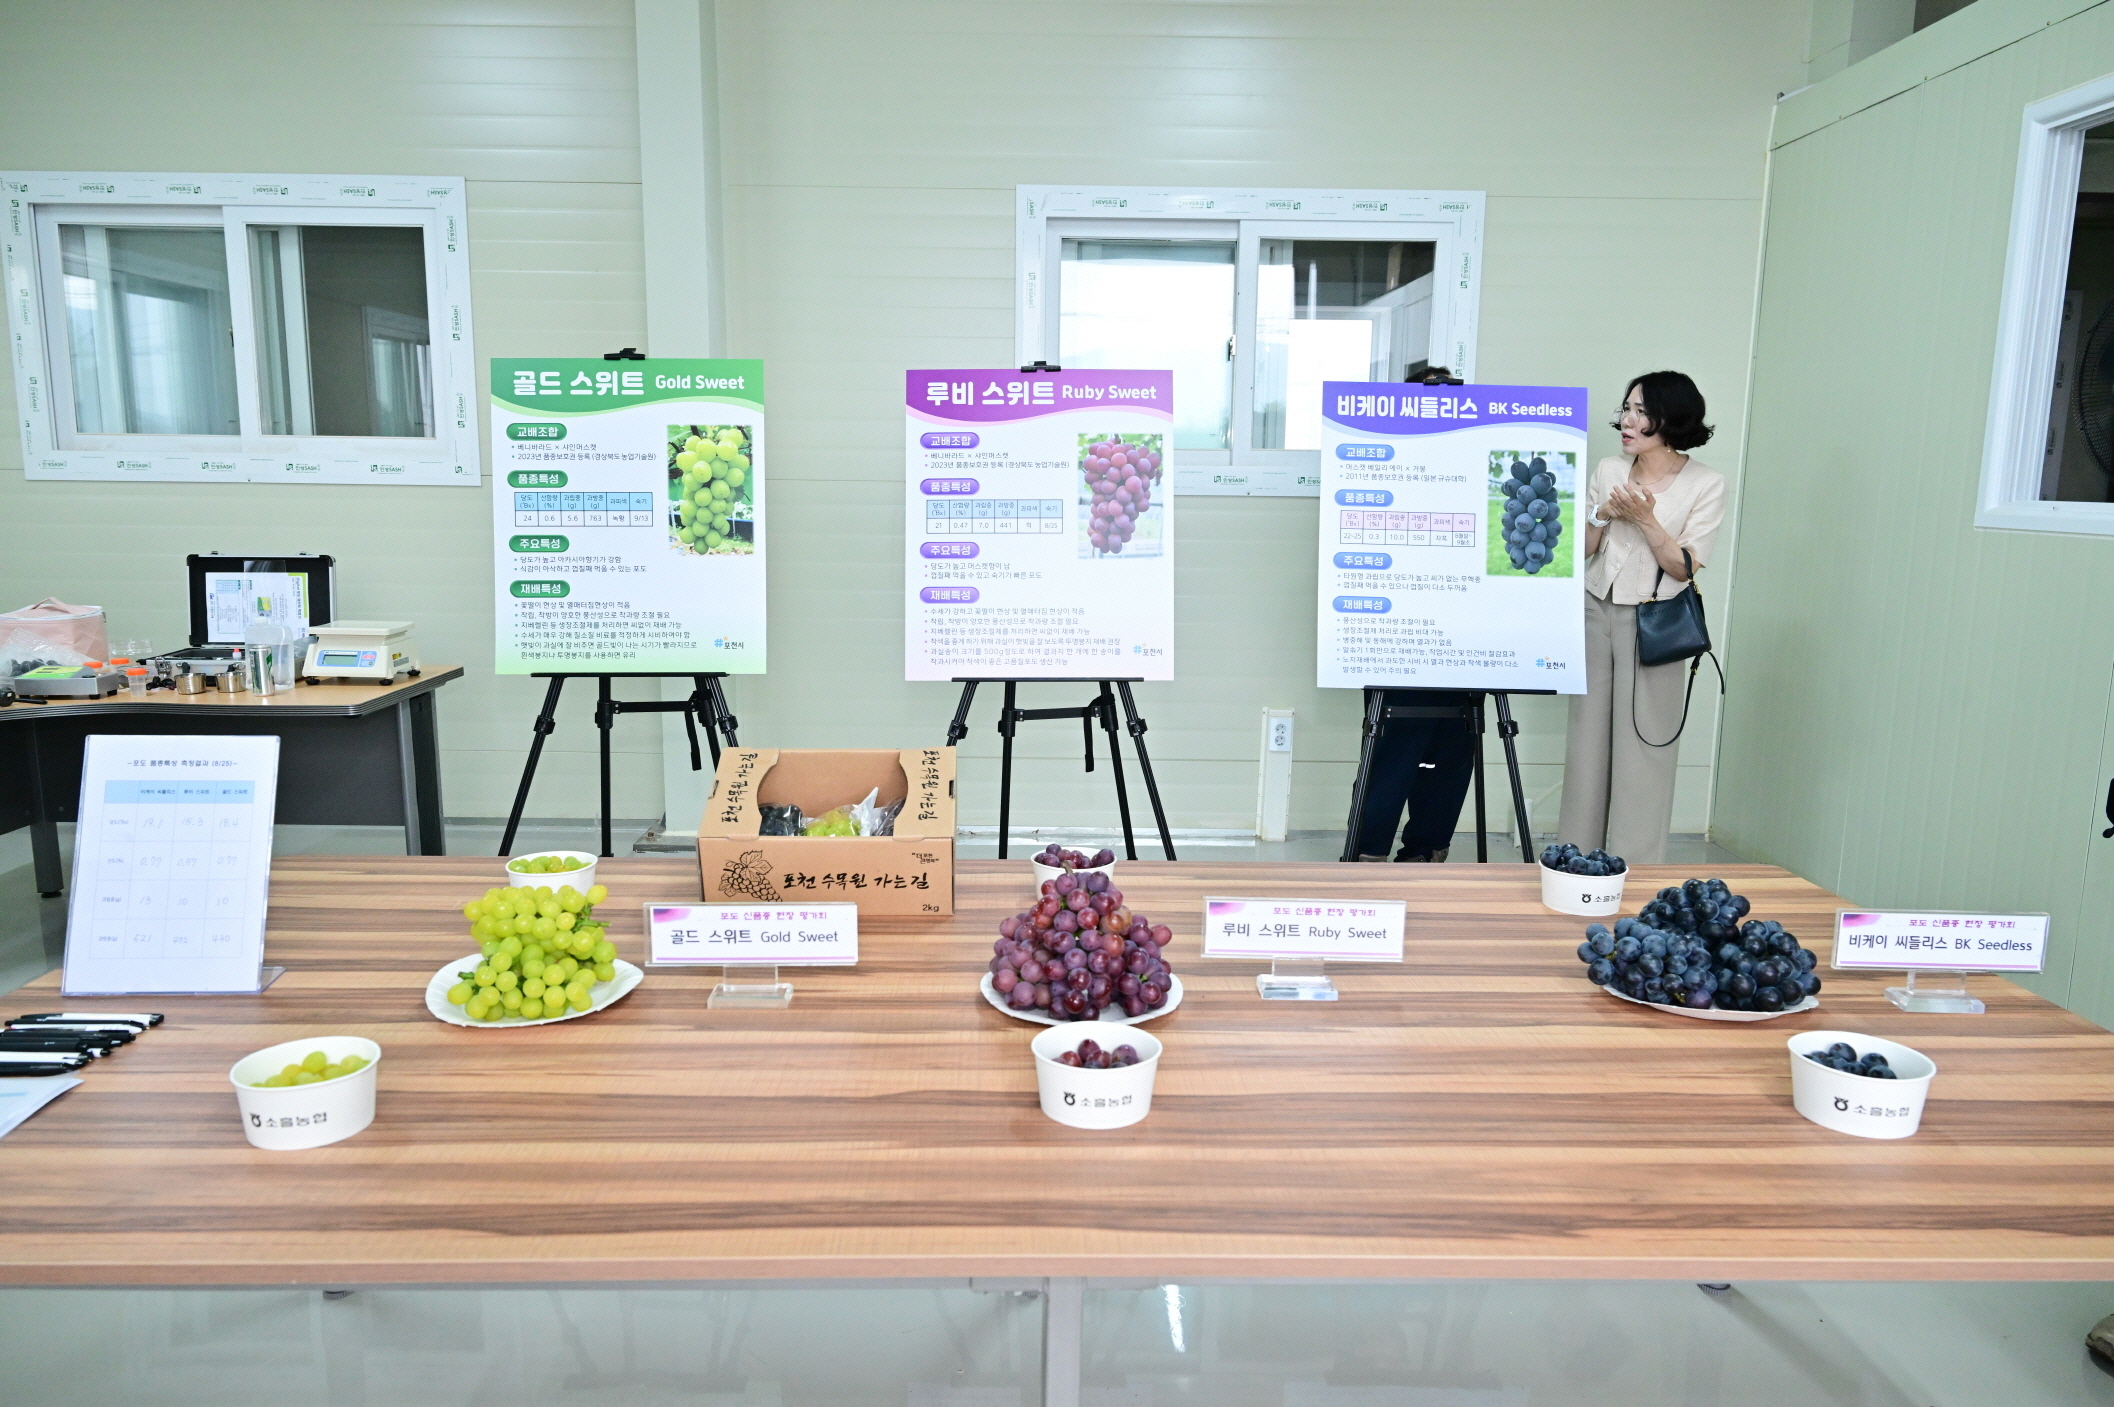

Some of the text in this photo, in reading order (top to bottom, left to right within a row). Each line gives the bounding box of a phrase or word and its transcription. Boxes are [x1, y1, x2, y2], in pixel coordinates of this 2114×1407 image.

[513, 370, 745, 396] 골드 스위트 Gold Sweet
[926, 381, 1156, 406] 루비 스위트 Ruby Sweet
[1337, 395, 1572, 419] 비케이 씨들리스 BK Seedless
[517, 427, 559, 437] 교배조합
[930, 436, 971, 446] 교배조합
[518, 453, 542, 461] 2023년
[1346, 447, 1386, 458] 교배조합
[518, 474, 559, 484] 품종특성
[931, 482, 971, 492] 품종특성
[1345, 492, 1385, 504] 품종특성
[520, 539, 560, 549] 주요특성
[930, 545, 971, 556] 주요특성
[1343, 555, 1384, 566] 주요특성
[520, 584, 561, 594] 재배특성
[930, 590, 971, 601] 재배특성
[1343, 599, 1383, 611] 재배특성
[783, 872, 930, 890] 포천 수목원 가는 길
[922, 904, 940, 912] 2kg
[670, 929, 839, 944] 골드 스위트 Gold Sweet
[1222, 923, 1387, 940] 루비 스위트 Ruby Sweet
[1849, 934, 2033, 951] 비케이 씨들리스 BK Seedless
